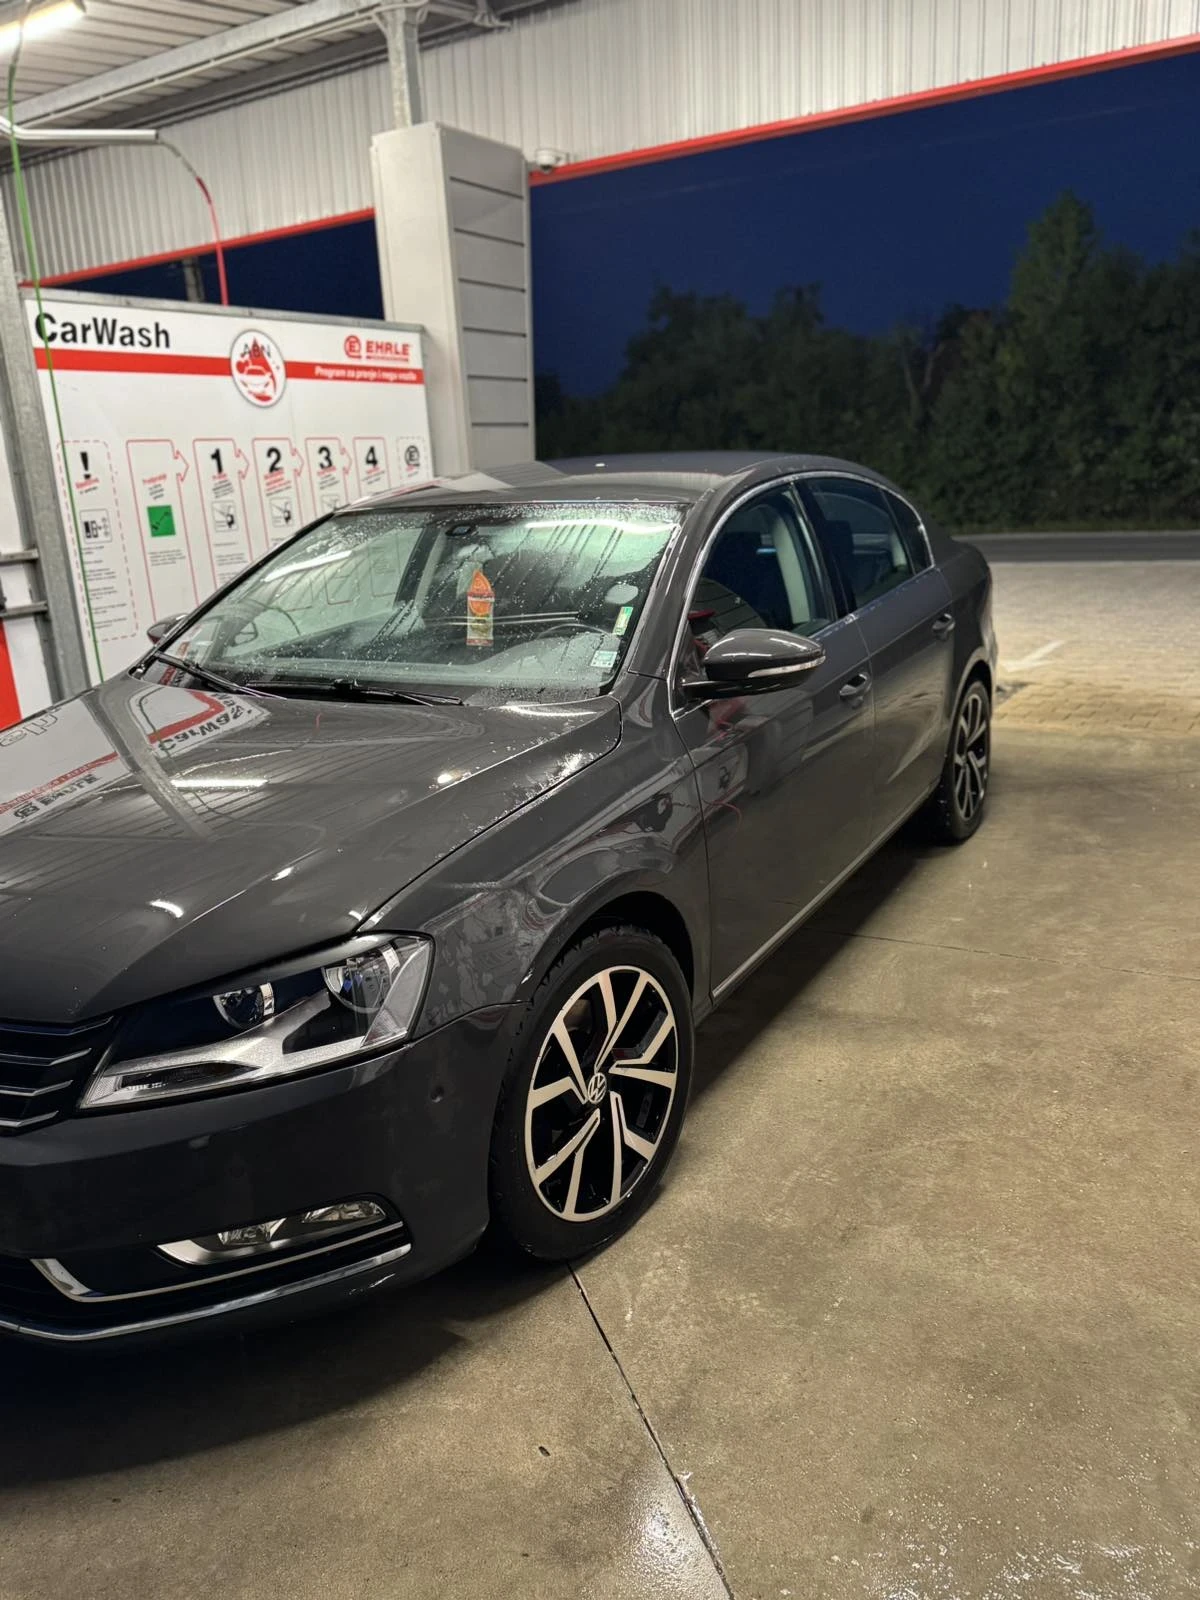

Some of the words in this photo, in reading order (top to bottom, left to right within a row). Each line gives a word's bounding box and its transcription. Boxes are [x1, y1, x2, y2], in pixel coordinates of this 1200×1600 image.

[34, 312, 170, 349] CarWash
[365, 340, 410, 356] EHRLE
[210, 448, 223, 474] 1
[266, 446, 282, 473] 2
[318, 446, 333, 470] 3
[365, 445, 379, 468] 4
